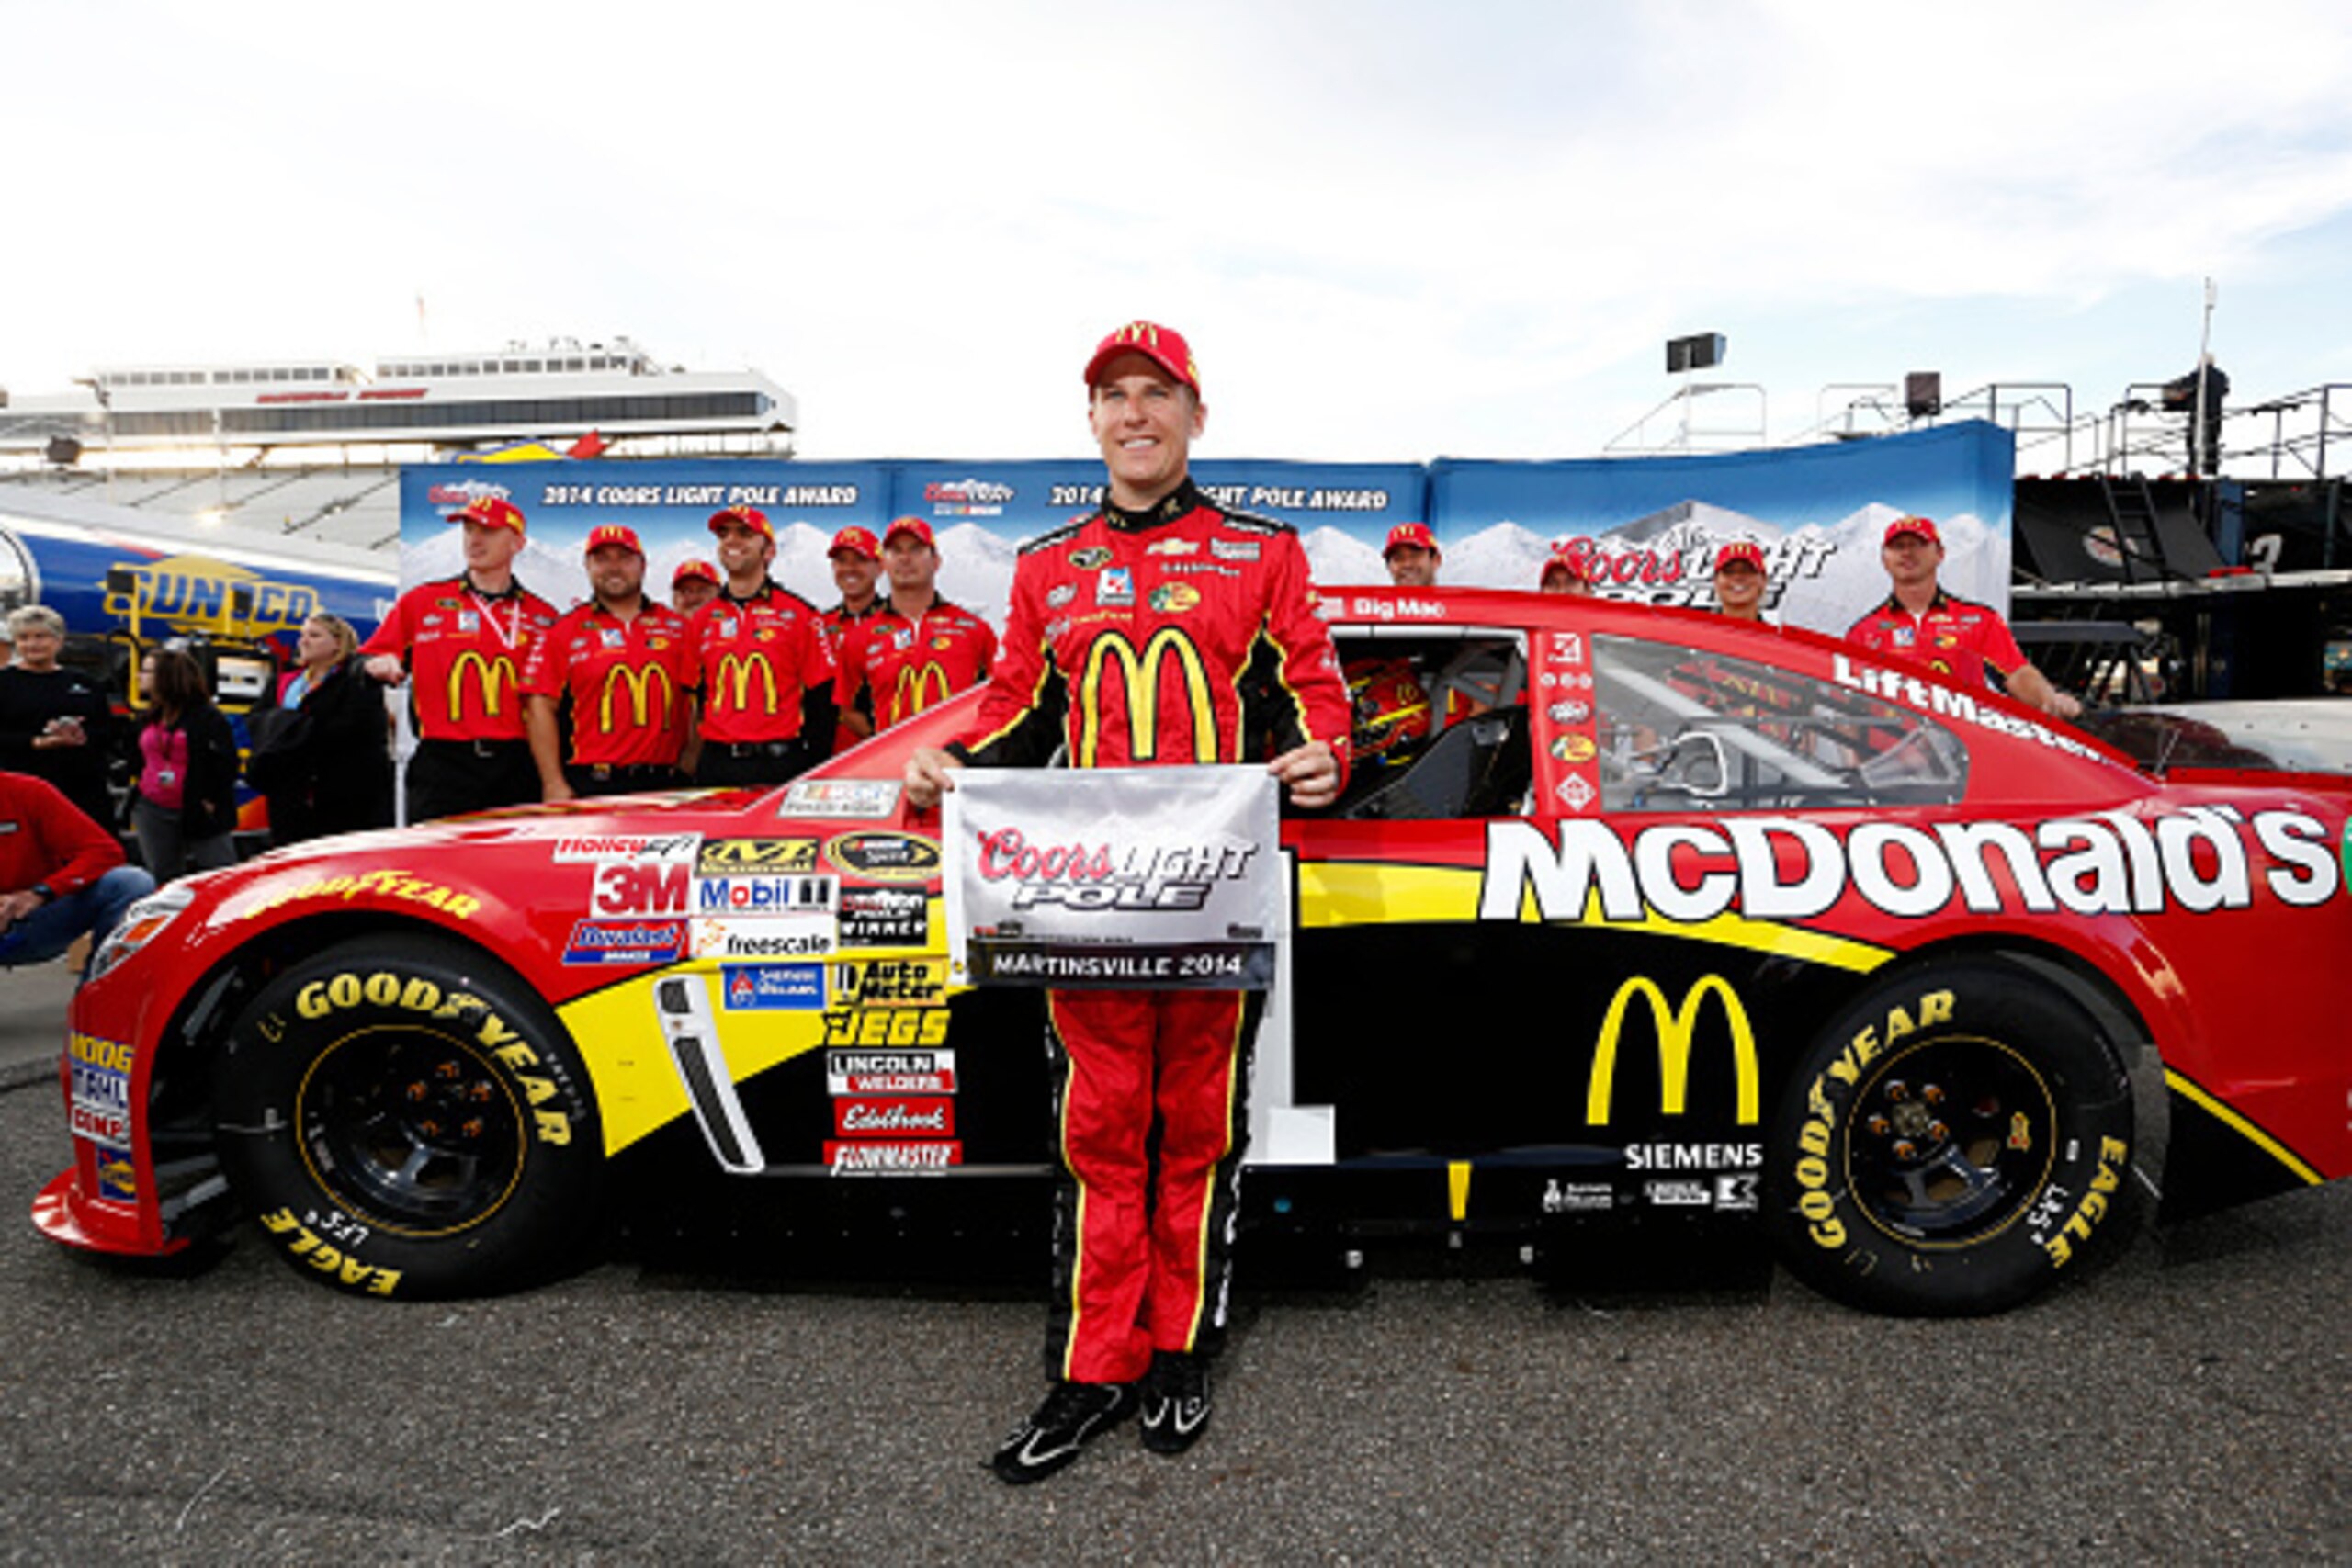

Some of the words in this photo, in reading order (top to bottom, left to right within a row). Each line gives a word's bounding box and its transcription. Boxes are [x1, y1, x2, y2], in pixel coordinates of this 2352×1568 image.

[596, 484, 661, 505] COORS
[664, 485, 726, 505] LIGHT
[728, 485, 780, 506] POLE
[783, 485, 858, 506] AWARD
[1050, 485, 1102, 504] 2014
[1250, 486, 1306, 508] POLE
[1309, 488, 1390, 510] AWARD
[1354, 597, 1395, 621] Big
[1397, 597, 1445, 618] Mac
[1833, 652, 2113, 766] LiftMaster
[977, 827, 1113, 882] Coors
[1111, 842, 1260, 882] LIGHT
[1478, 805, 2341, 921] McDonald's
[597, 863, 689, 914] 3M
[700, 878, 789, 908] Mobil
[1011, 882, 1213, 912] POLE
[726, 934, 832, 955] freescale
[862, 962, 929, 979] Auto
[992, 953, 1173, 977] MARTINSVILLE
[1178, 953, 1243, 977] 2014
[856, 980, 944, 1000] Meter
[827, 1009, 952, 1046] JEGS
[70, 1030, 135, 1075] MOOG
[296, 972, 572, 1146] GOODYEAR
[834, 1055, 933, 1073] LINCOLN
[842, 1103, 945, 1130] Edelbrock
[1795, 988, 1958, 1249] GOODYEAR
[1624, 1143, 1764, 1170] SIEMENS
[2043, 1134, 2129, 1269] EAGLE
[259, 1206, 404, 1296] EAGLE
